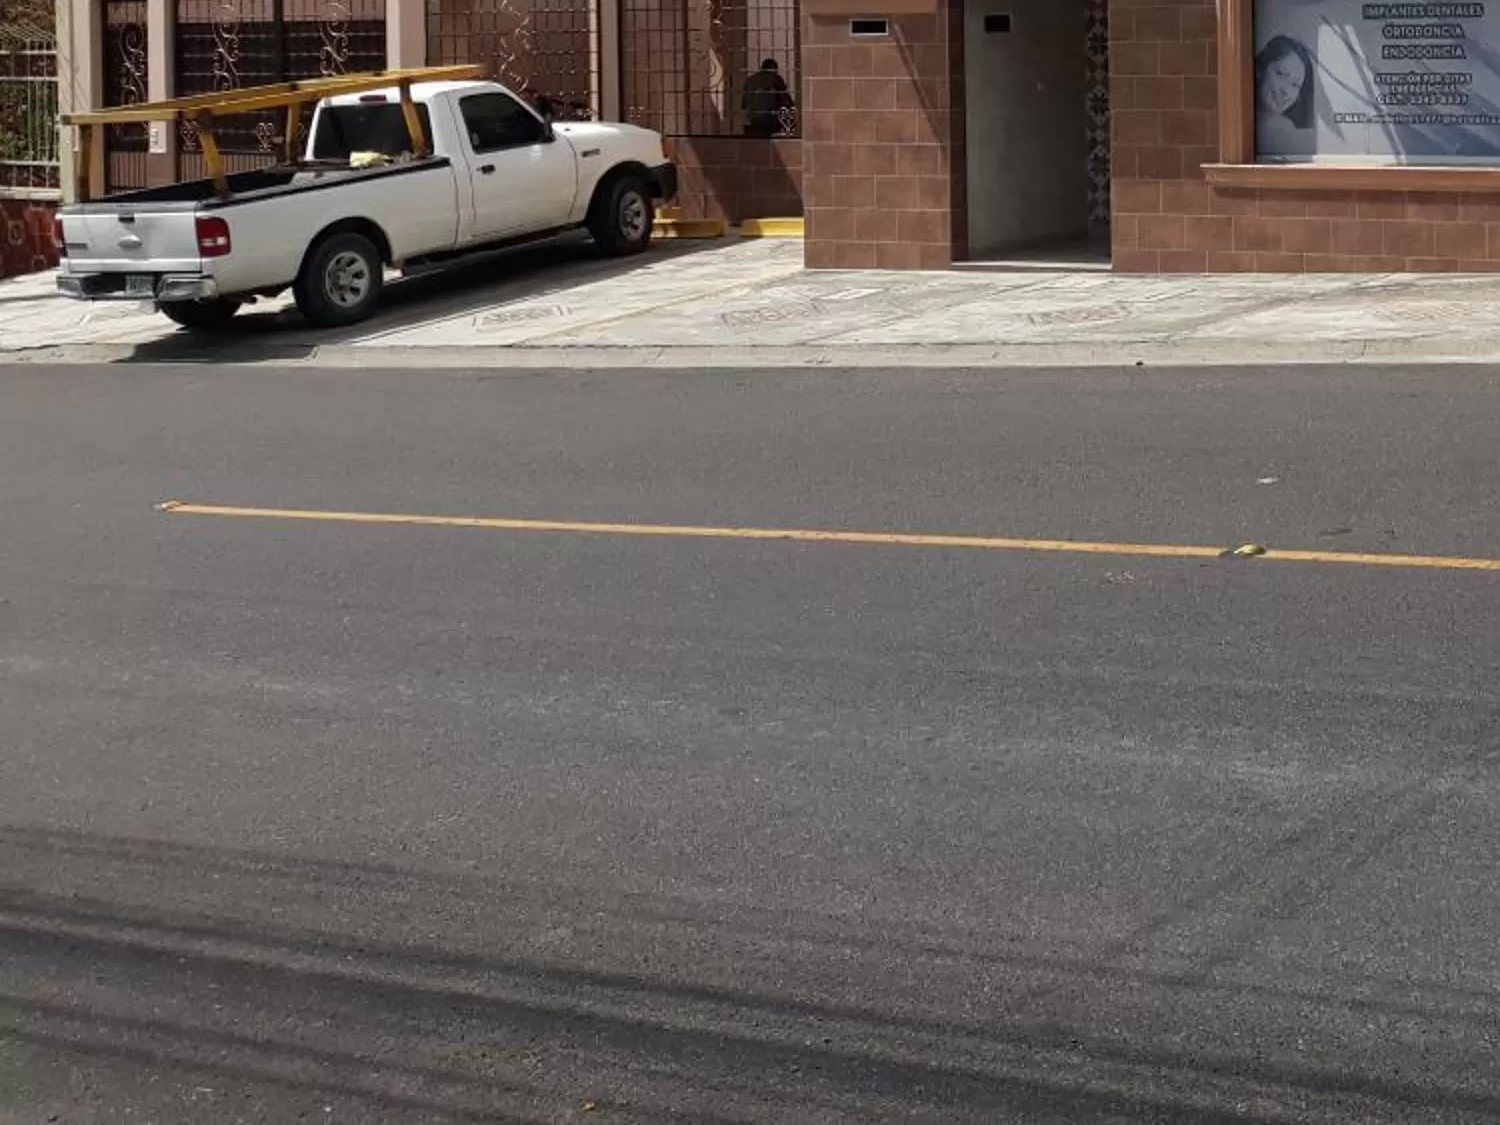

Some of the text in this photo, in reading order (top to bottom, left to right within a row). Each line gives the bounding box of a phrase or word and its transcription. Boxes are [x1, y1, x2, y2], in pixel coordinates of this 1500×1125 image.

[1362, 2, 1484, 20] IMPLANTES DENTALES
[1383, 24, 1466, 39] ORTODONCIA
[1382, 44, 1466, 59] ENDODONCIA
